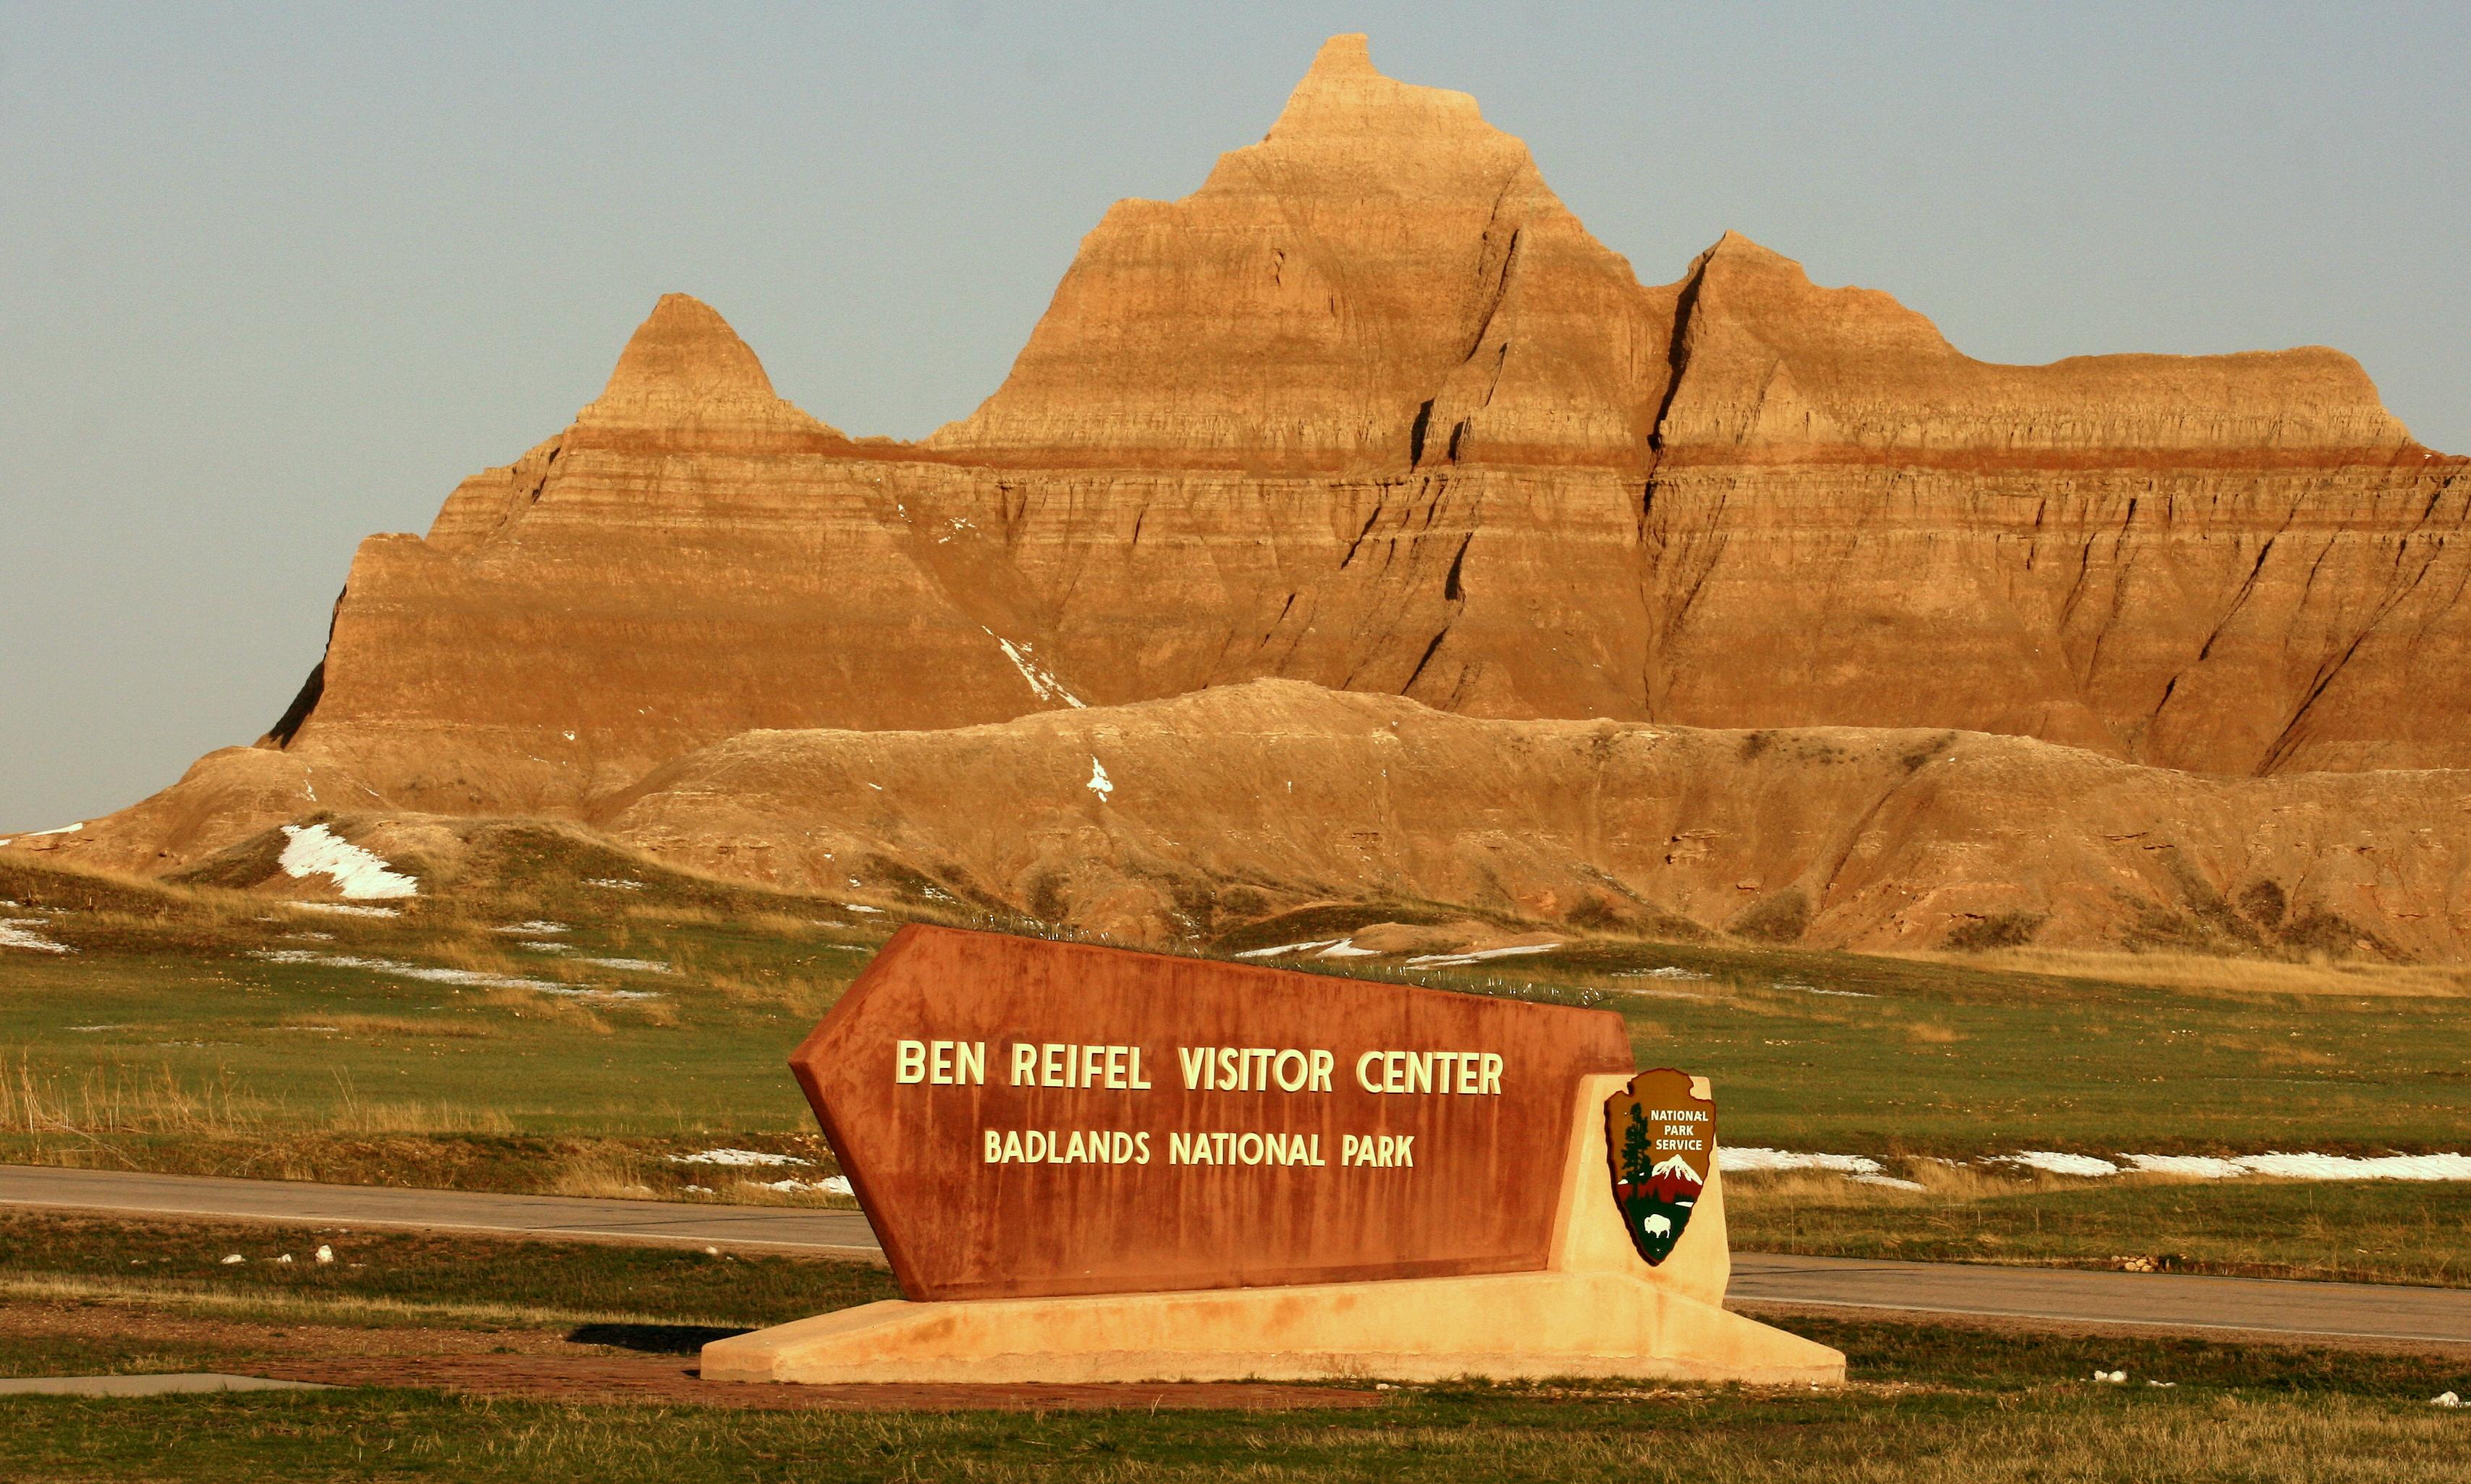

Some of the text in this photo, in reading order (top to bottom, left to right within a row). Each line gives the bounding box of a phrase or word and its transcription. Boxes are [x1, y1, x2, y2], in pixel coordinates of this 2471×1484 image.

[896, 1040, 1503, 1095] BEN REIFEL VISITOR CENTER
[1651, 1109, 1708, 1122] NATIONAL
[1665, 1124, 1694, 1136] PARK
[984, 1130, 1415, 1168] BADLANDS NATIONAL PARK
[1655, 1139, 1702, 1150] SERVICE
